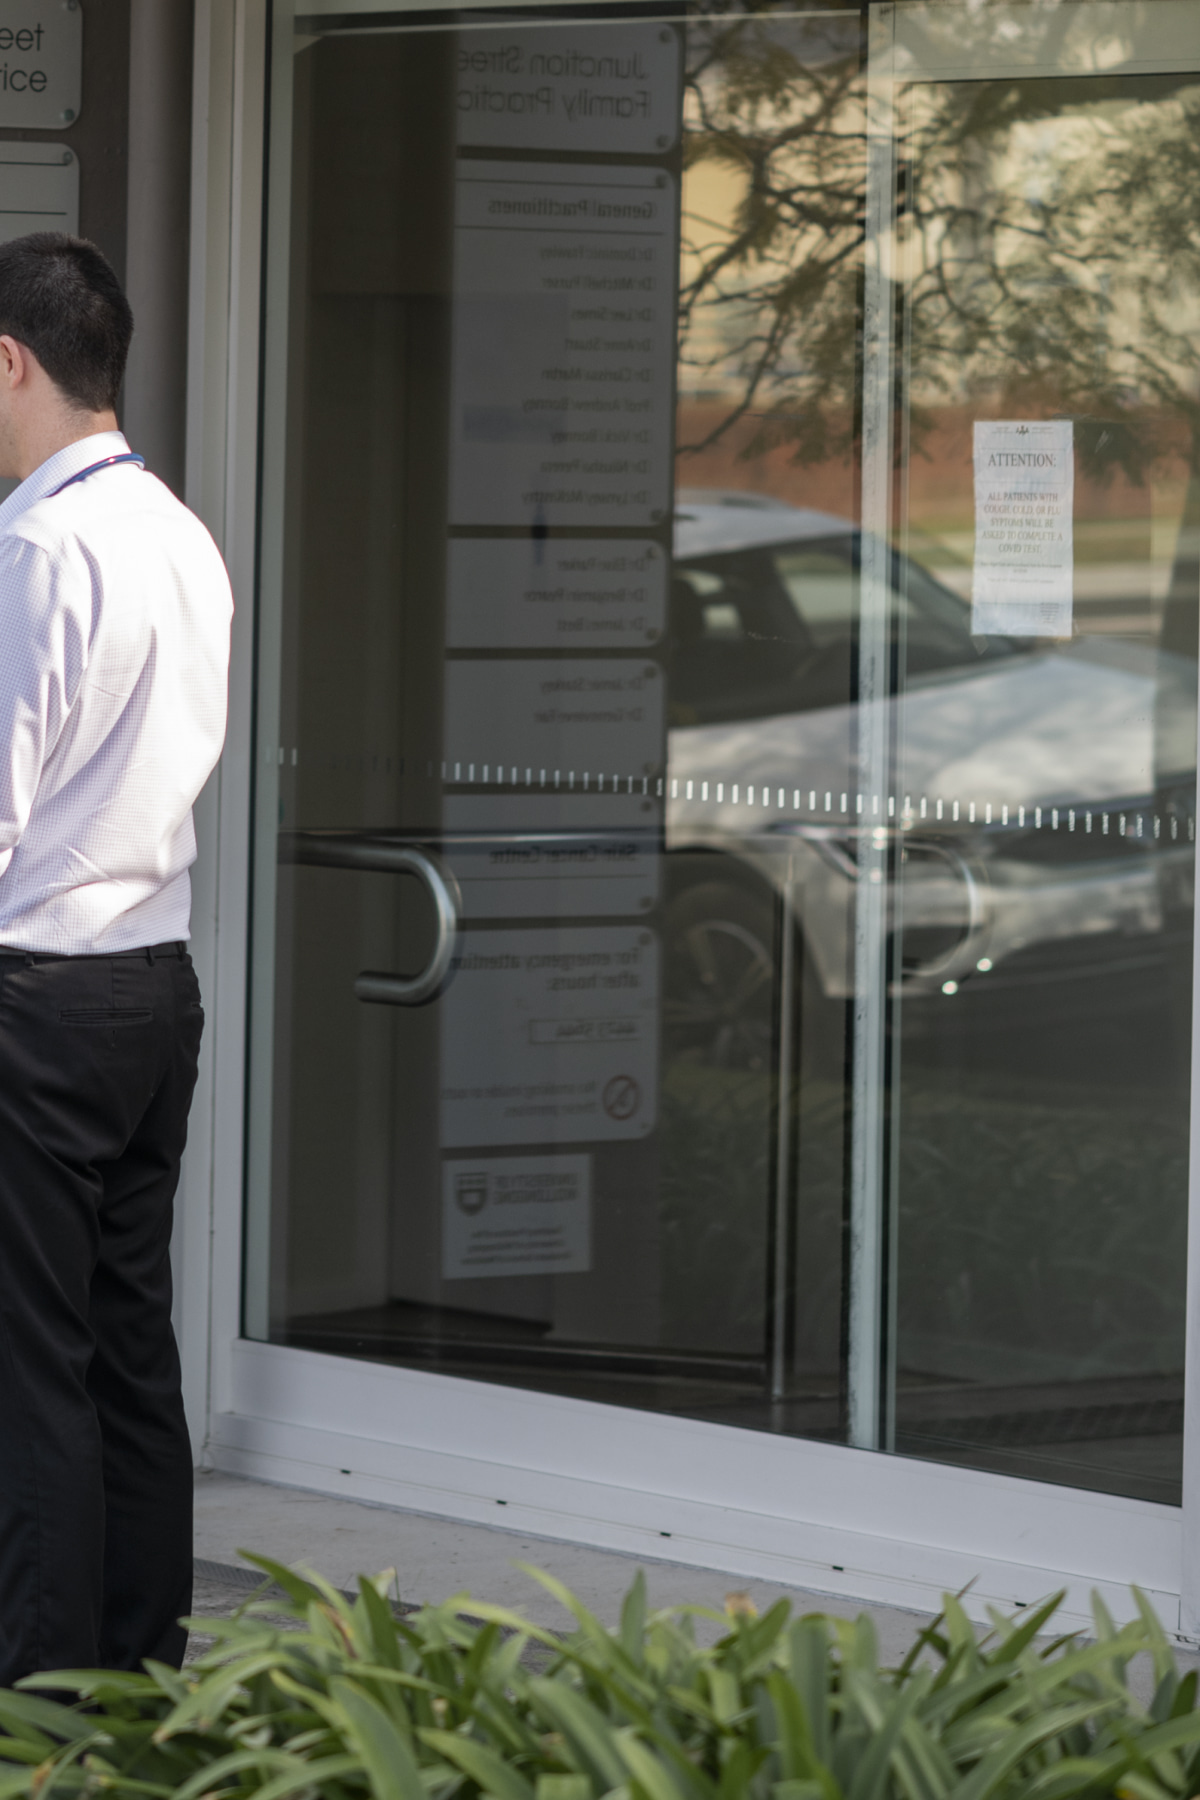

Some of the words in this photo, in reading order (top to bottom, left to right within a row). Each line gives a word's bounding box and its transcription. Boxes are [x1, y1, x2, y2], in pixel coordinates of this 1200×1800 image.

[988, 453, 1056, 467] ATTENTION:
[988, 493, 1002, 501] ALL
[1004, 493, 1037, 501] PATIENTS
[1039, 493, 1058, 502] WITH
[1025, 518, 1042, 528] WILL
[1045, 519, 1054, 528] BE
[999, 544, 1021, 553] COVID
